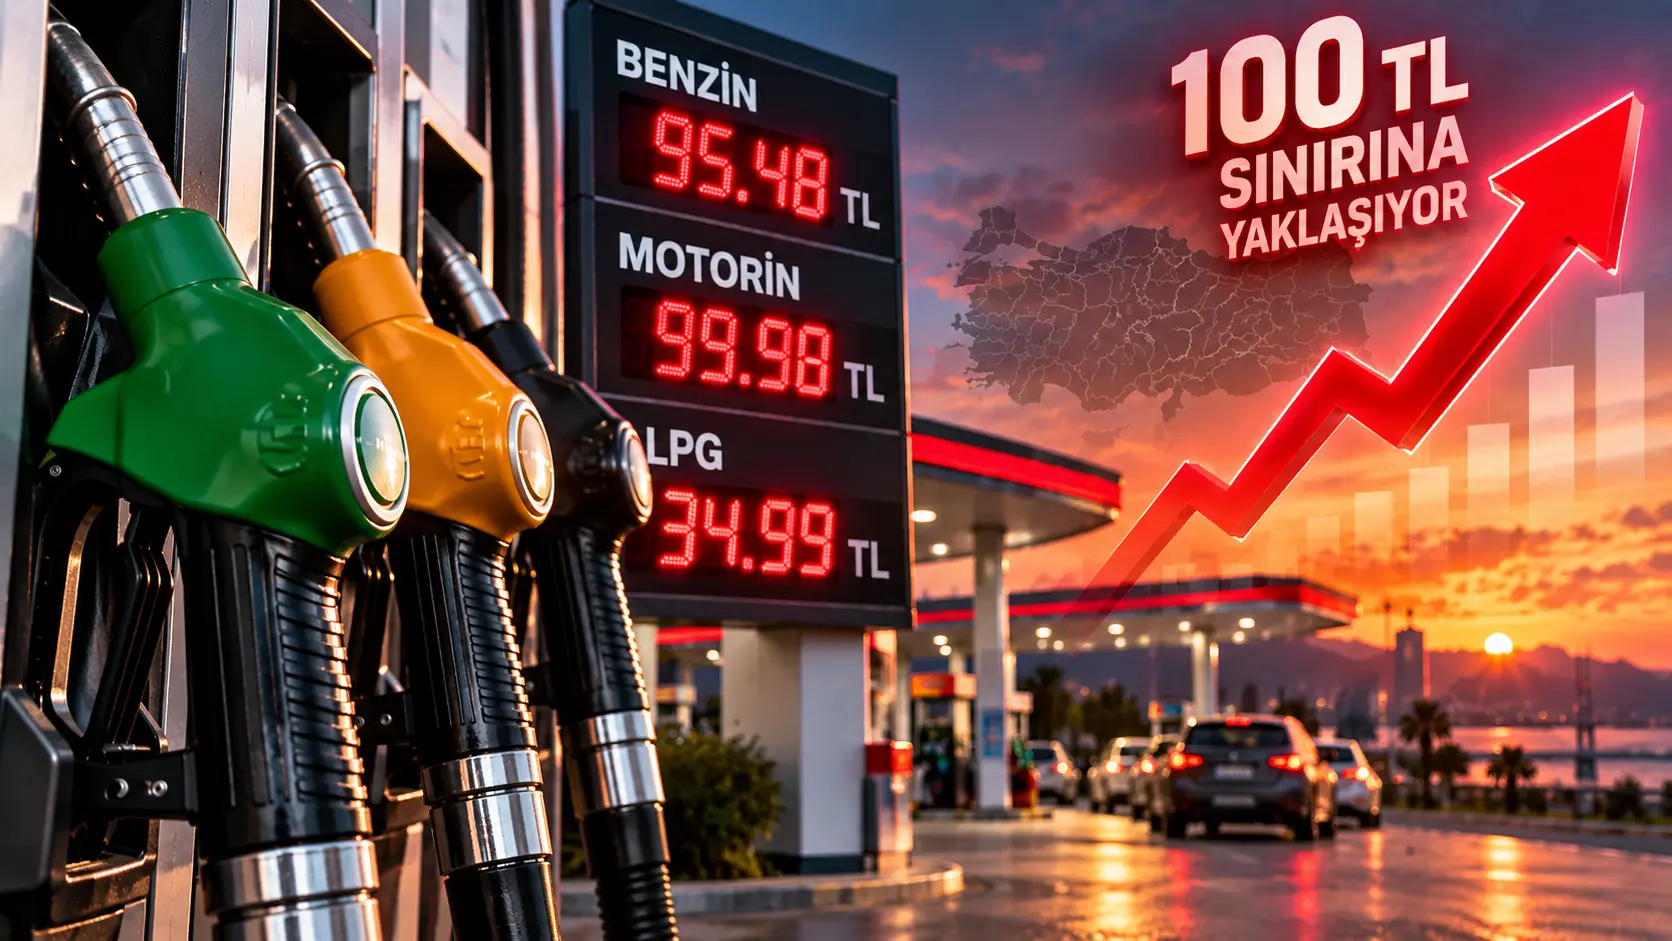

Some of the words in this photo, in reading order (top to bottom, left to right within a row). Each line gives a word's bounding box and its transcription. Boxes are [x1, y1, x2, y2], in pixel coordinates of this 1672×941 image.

[617, 39, 757, 112] BENZİN
[655, 112, 828, 220] 95.48
[840, 187, 881, 230] TL
[619, 232, 800, 301] MOTORİN
[656, 300, 831, 396] 99.98
[844, 361, 885, 403] TL
[646, 426, 723, 471] LPG
[660, 490, 836, 576] 34.99
[847, 539, 890, 579] TL
